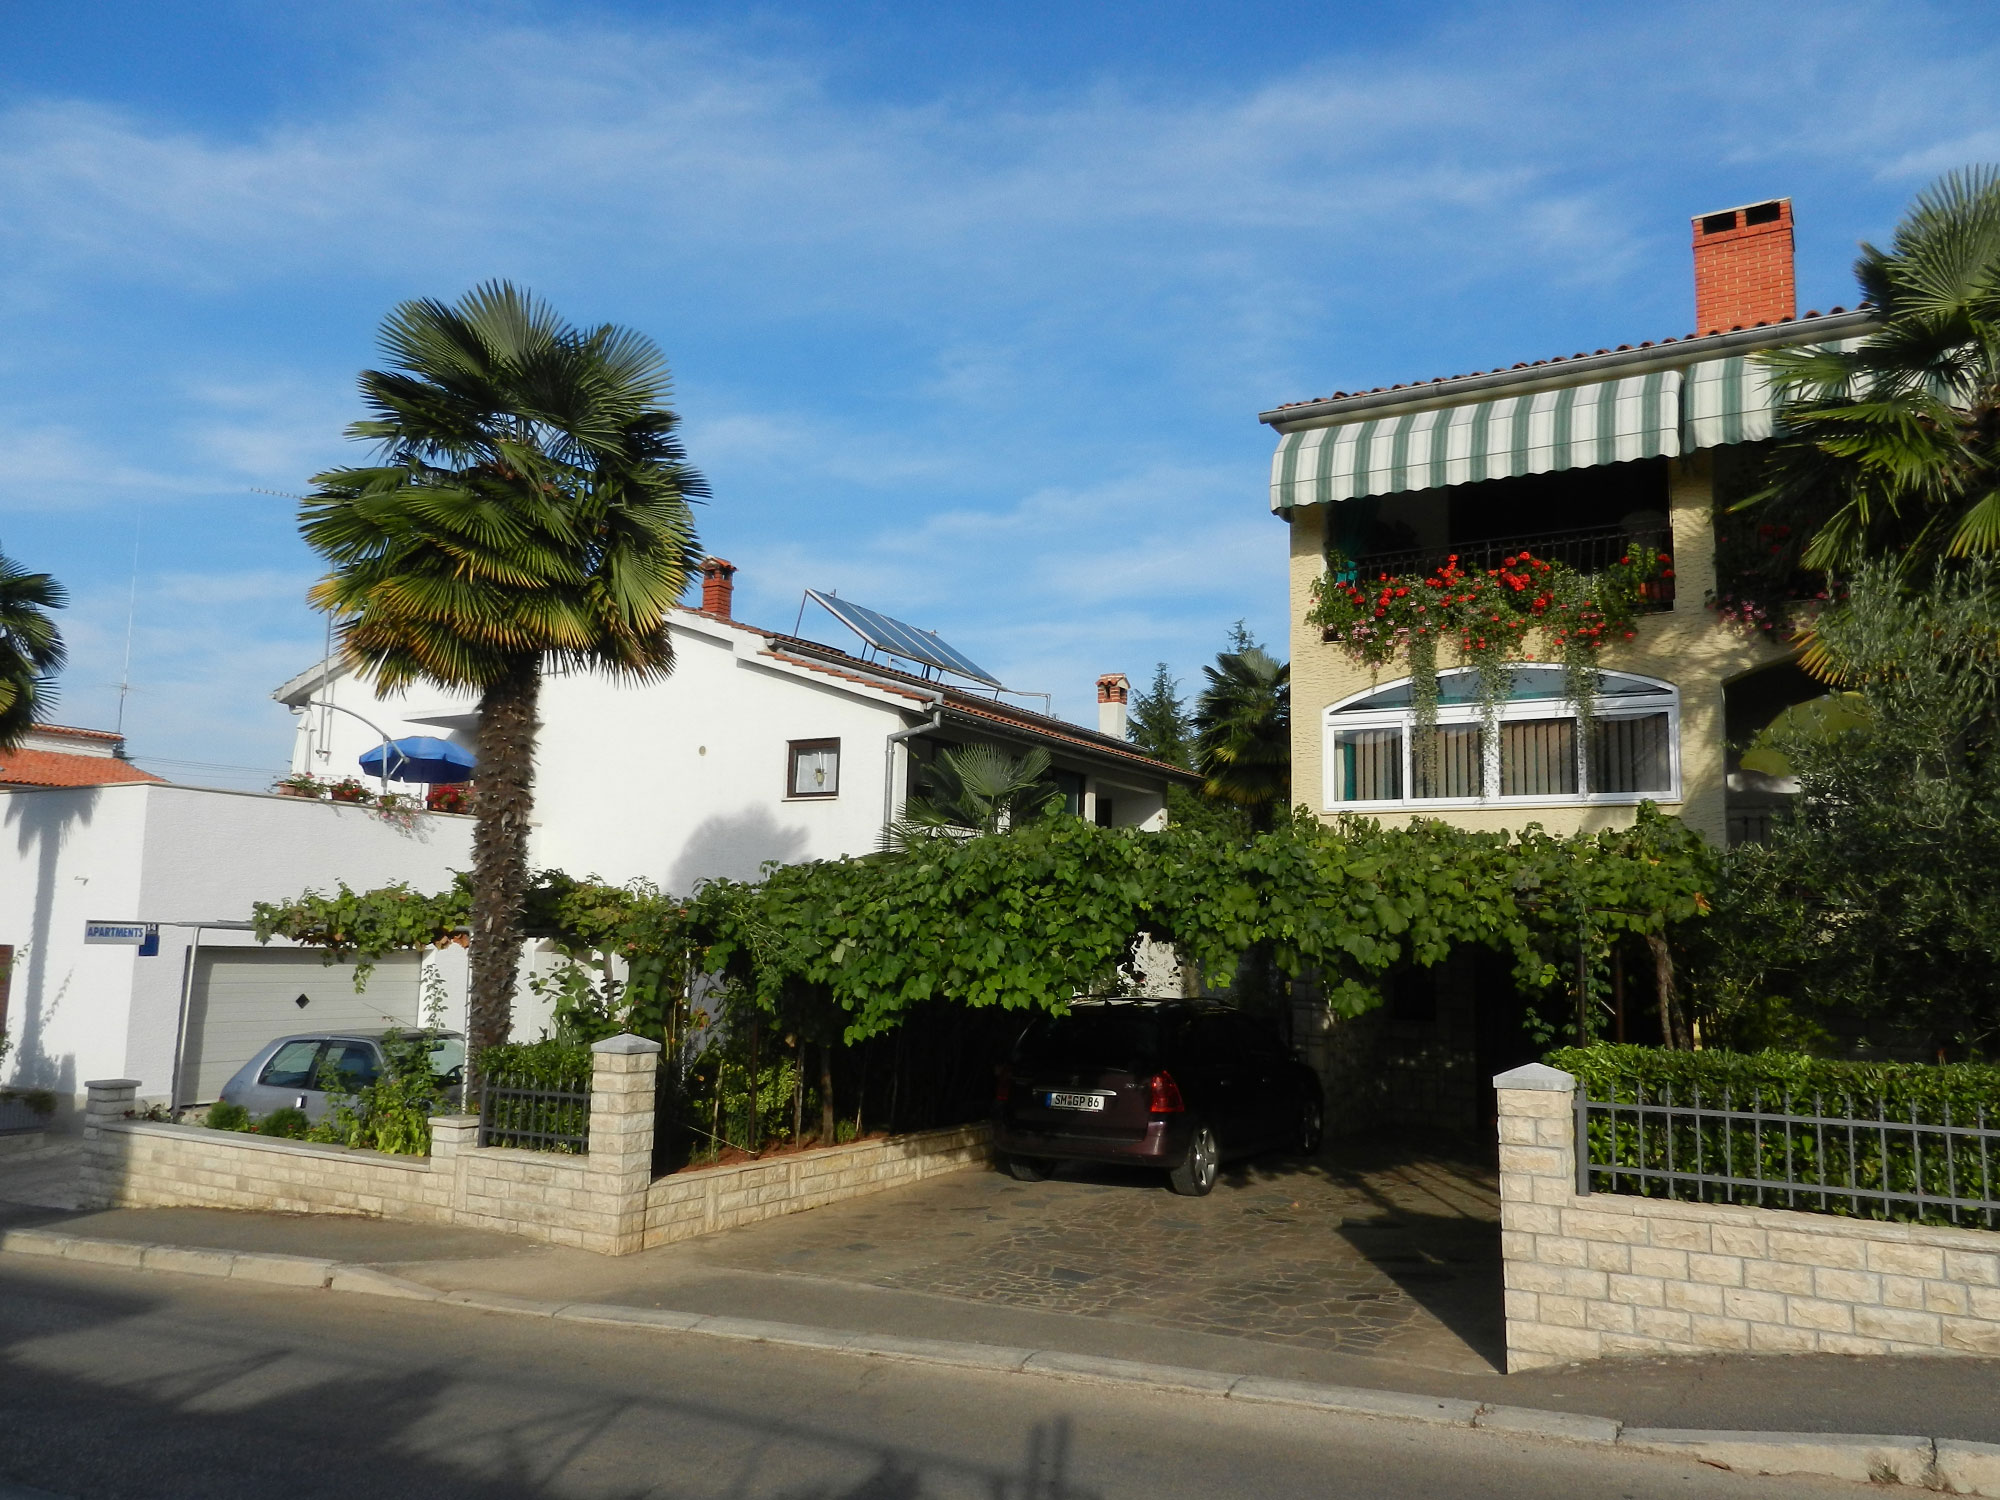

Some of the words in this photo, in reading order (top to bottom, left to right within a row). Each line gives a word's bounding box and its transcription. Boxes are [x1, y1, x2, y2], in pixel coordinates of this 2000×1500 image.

[88, 927, 144, 938] APARTMENTS
[1054, 1095, 1066, 1105] SM
[1072, 1096, 1085, 1107] GP
[1088, 1097, 1100, 1108] 86
